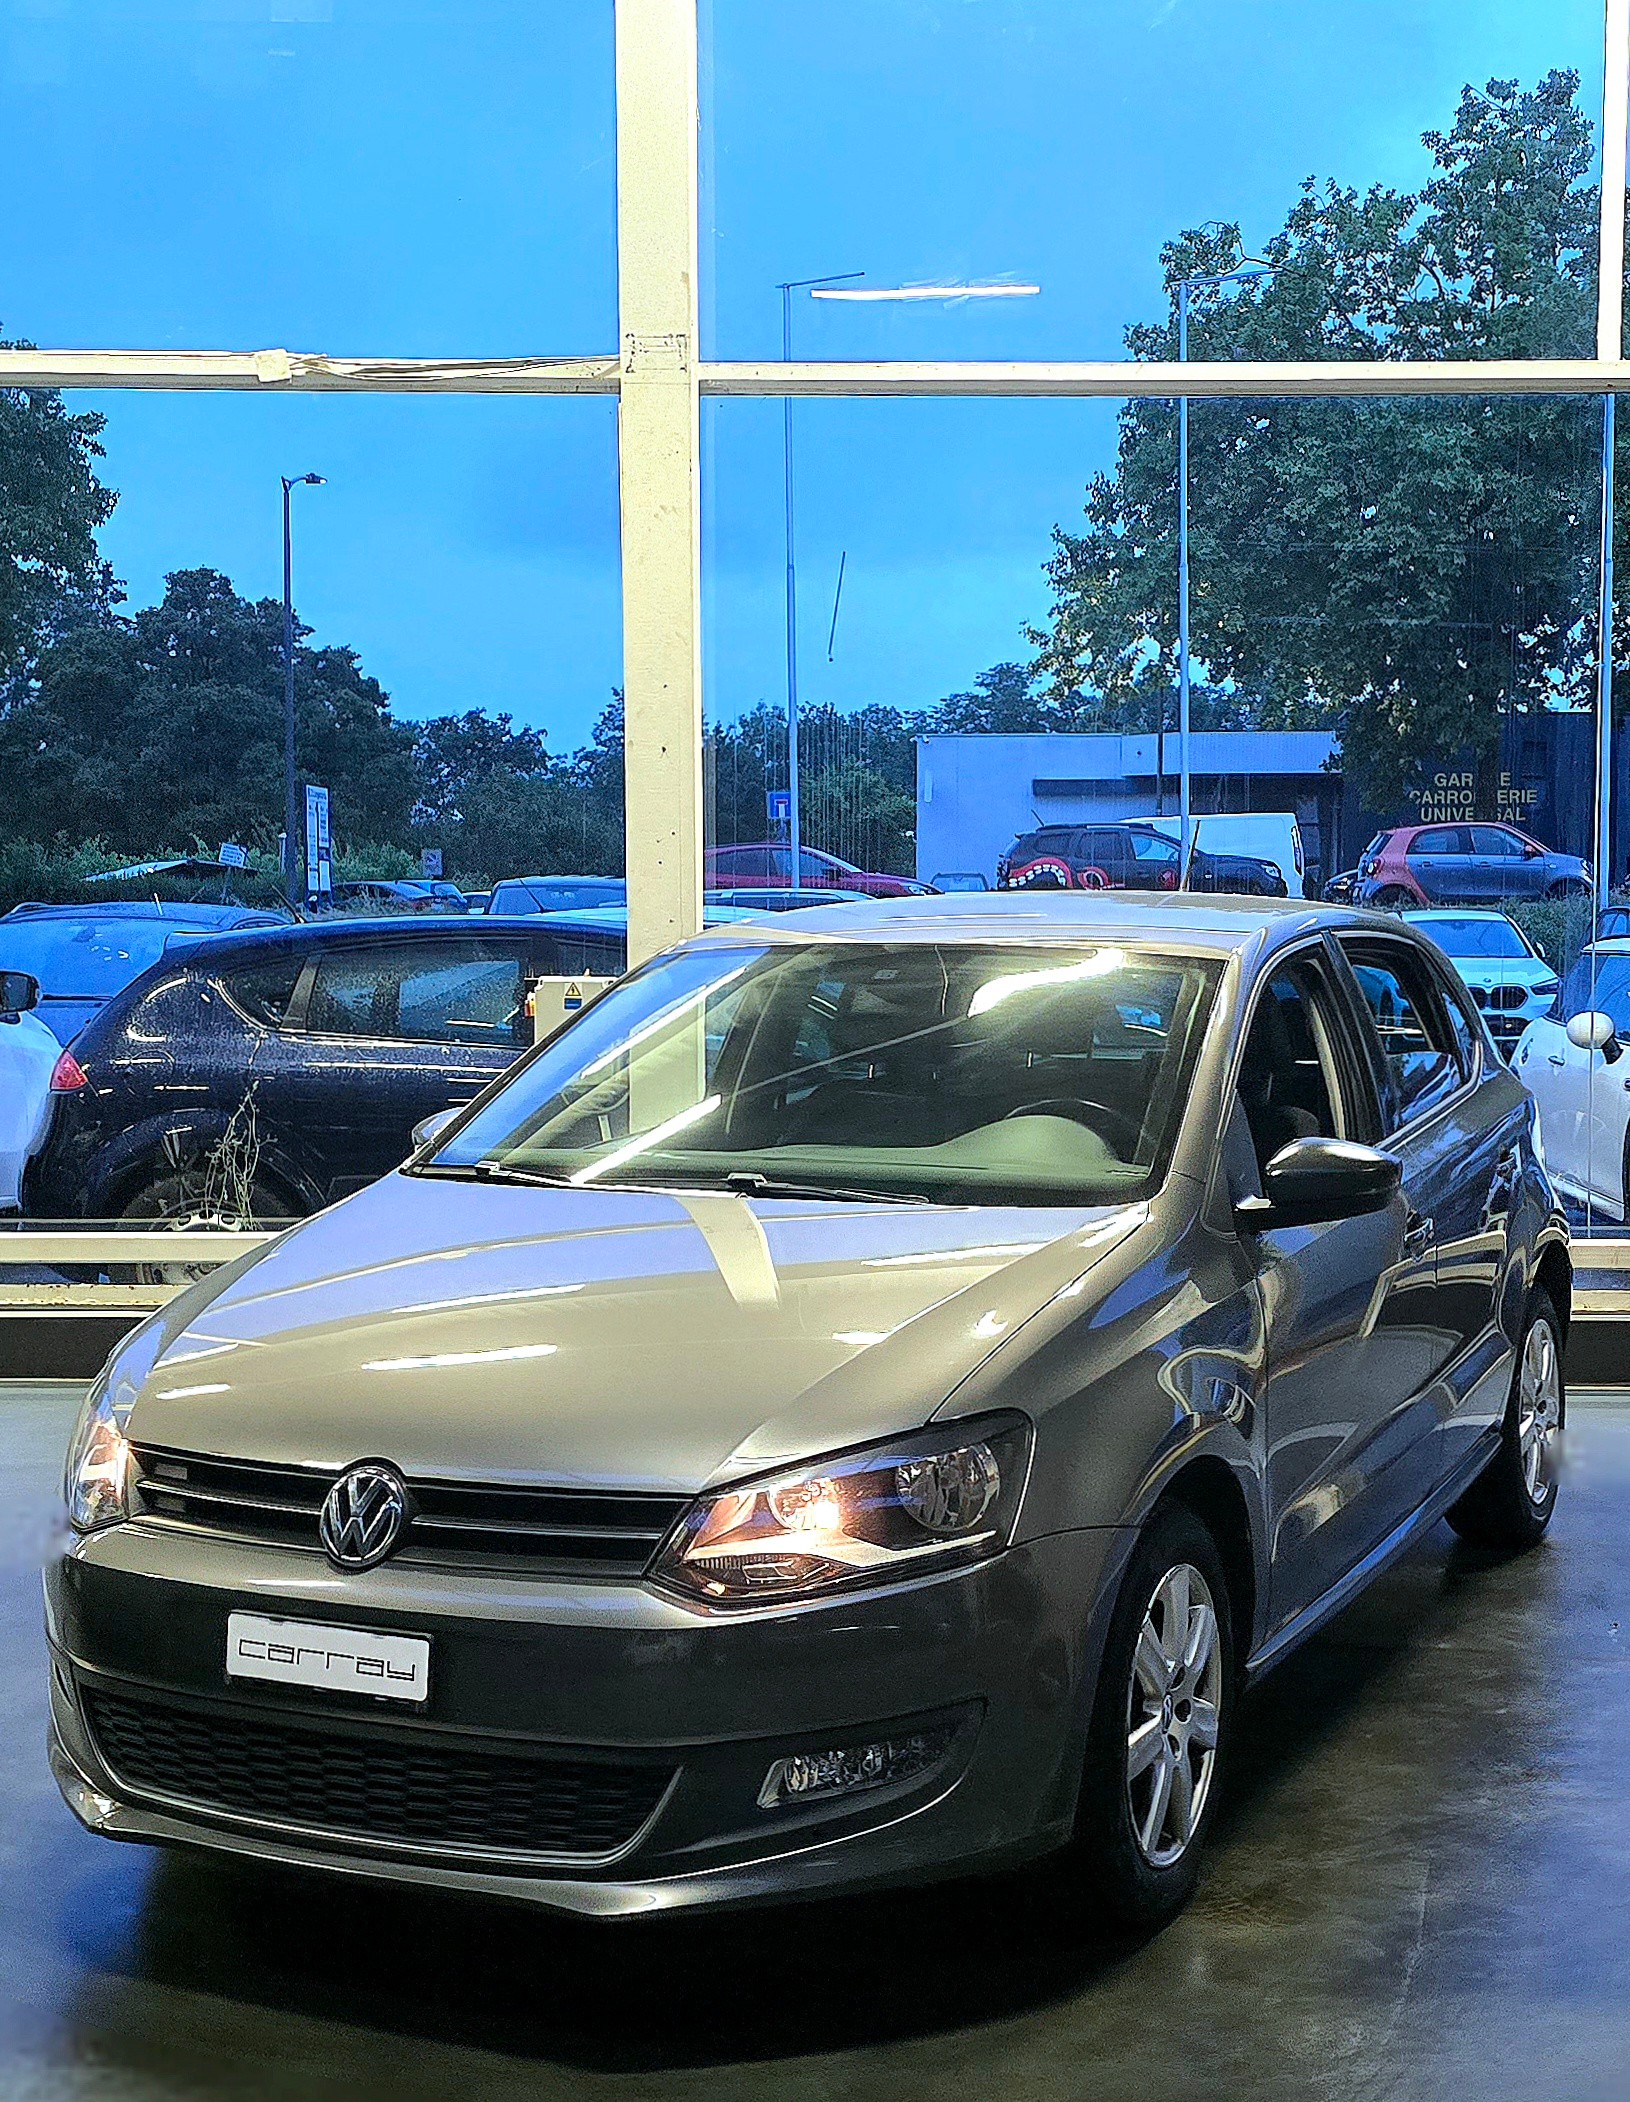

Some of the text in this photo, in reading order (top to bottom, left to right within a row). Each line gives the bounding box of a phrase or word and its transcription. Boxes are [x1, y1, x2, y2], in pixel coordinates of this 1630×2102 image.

[1434, 772, 1511, 787] GARE
[1409, 789, 1538, 804] CARROERIE
[1421, 806, 1526, 821] UNIVEAL
[325, 1472, 399, 1559] VW
[239, 1638, 416, 1682] carray
